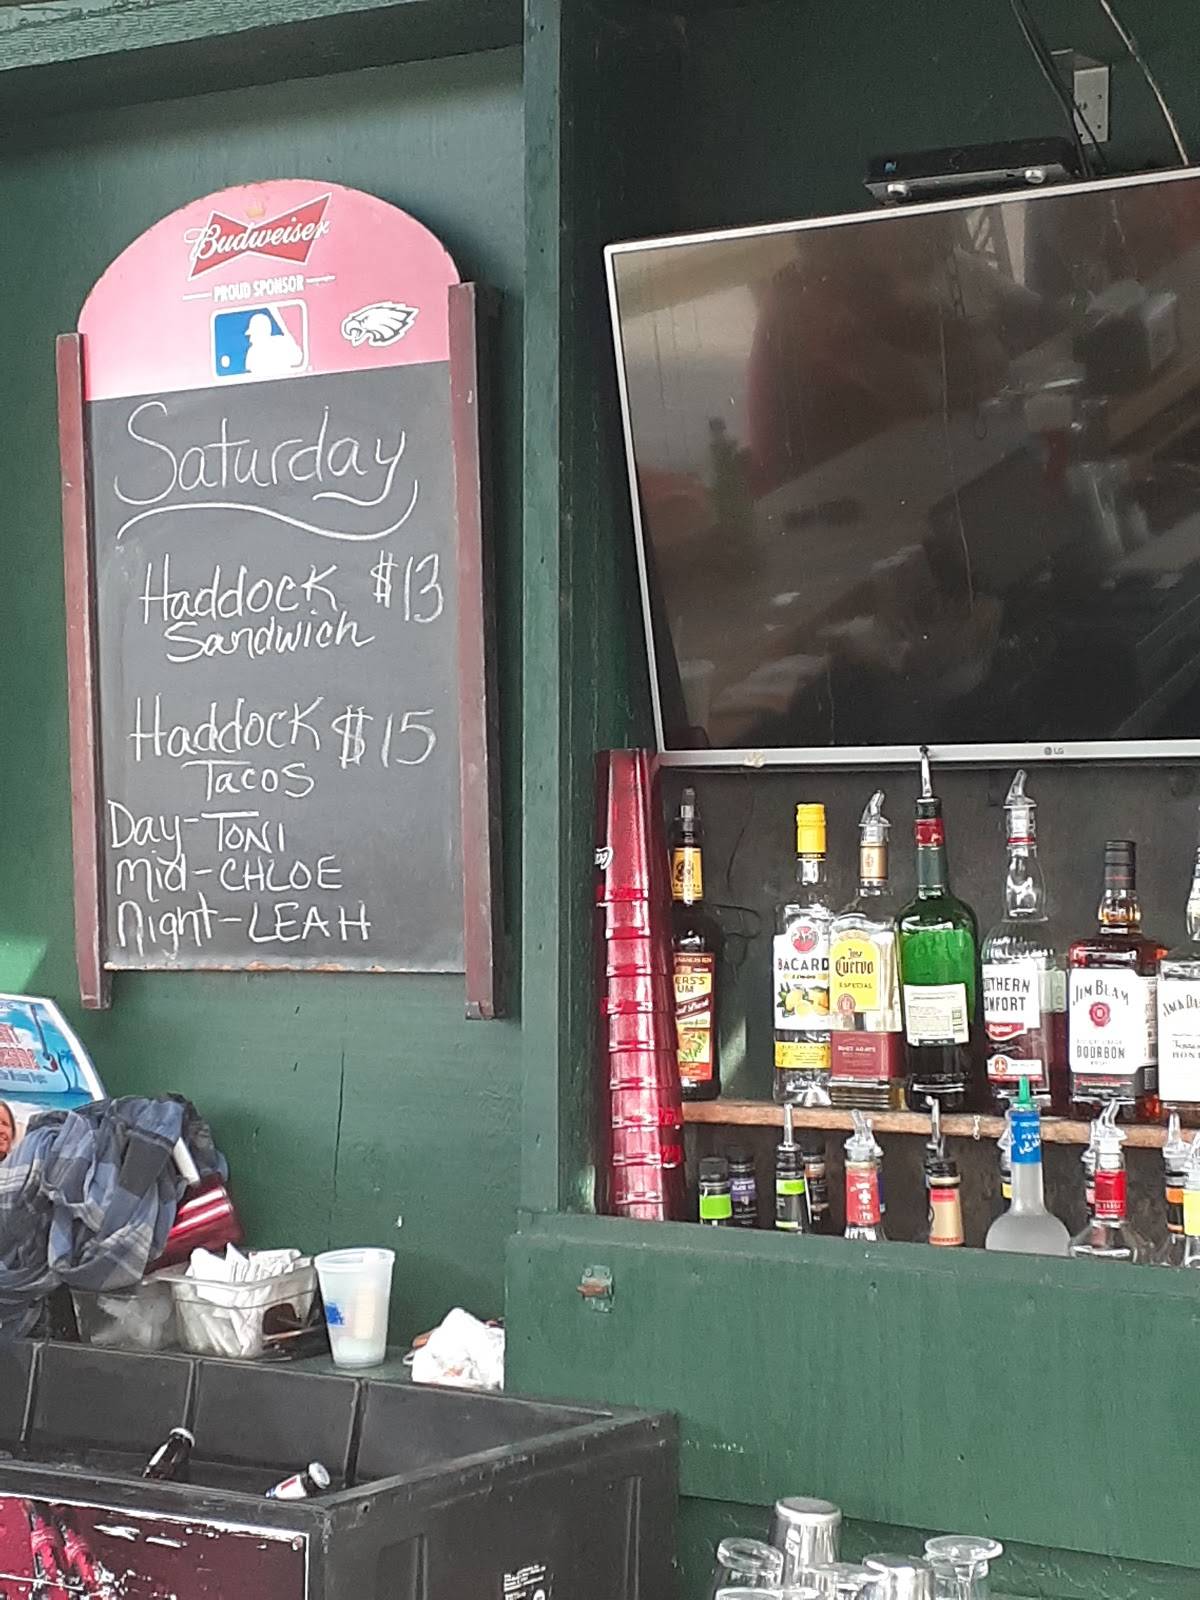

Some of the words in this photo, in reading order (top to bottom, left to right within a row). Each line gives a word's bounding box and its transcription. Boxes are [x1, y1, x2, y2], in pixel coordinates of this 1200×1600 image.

[184, 214, 331, 260] Budweiser
[214, 282, 251, 302] PROUD
[253, 274, 305, 297] SPONSOR
[114, 401, 407, 507] Saturday
[370, 550, 444, 624] $13
[164, 608, 376, 663] Sandwich
[331, 704, 437, 770] $15
[778, 957, 829, 971] BACARD
[835, 957, 874, 977] Cuervo
[677, 985, 694, 993] UM
[1076, 1045, 1126, 1060] BOURBON
